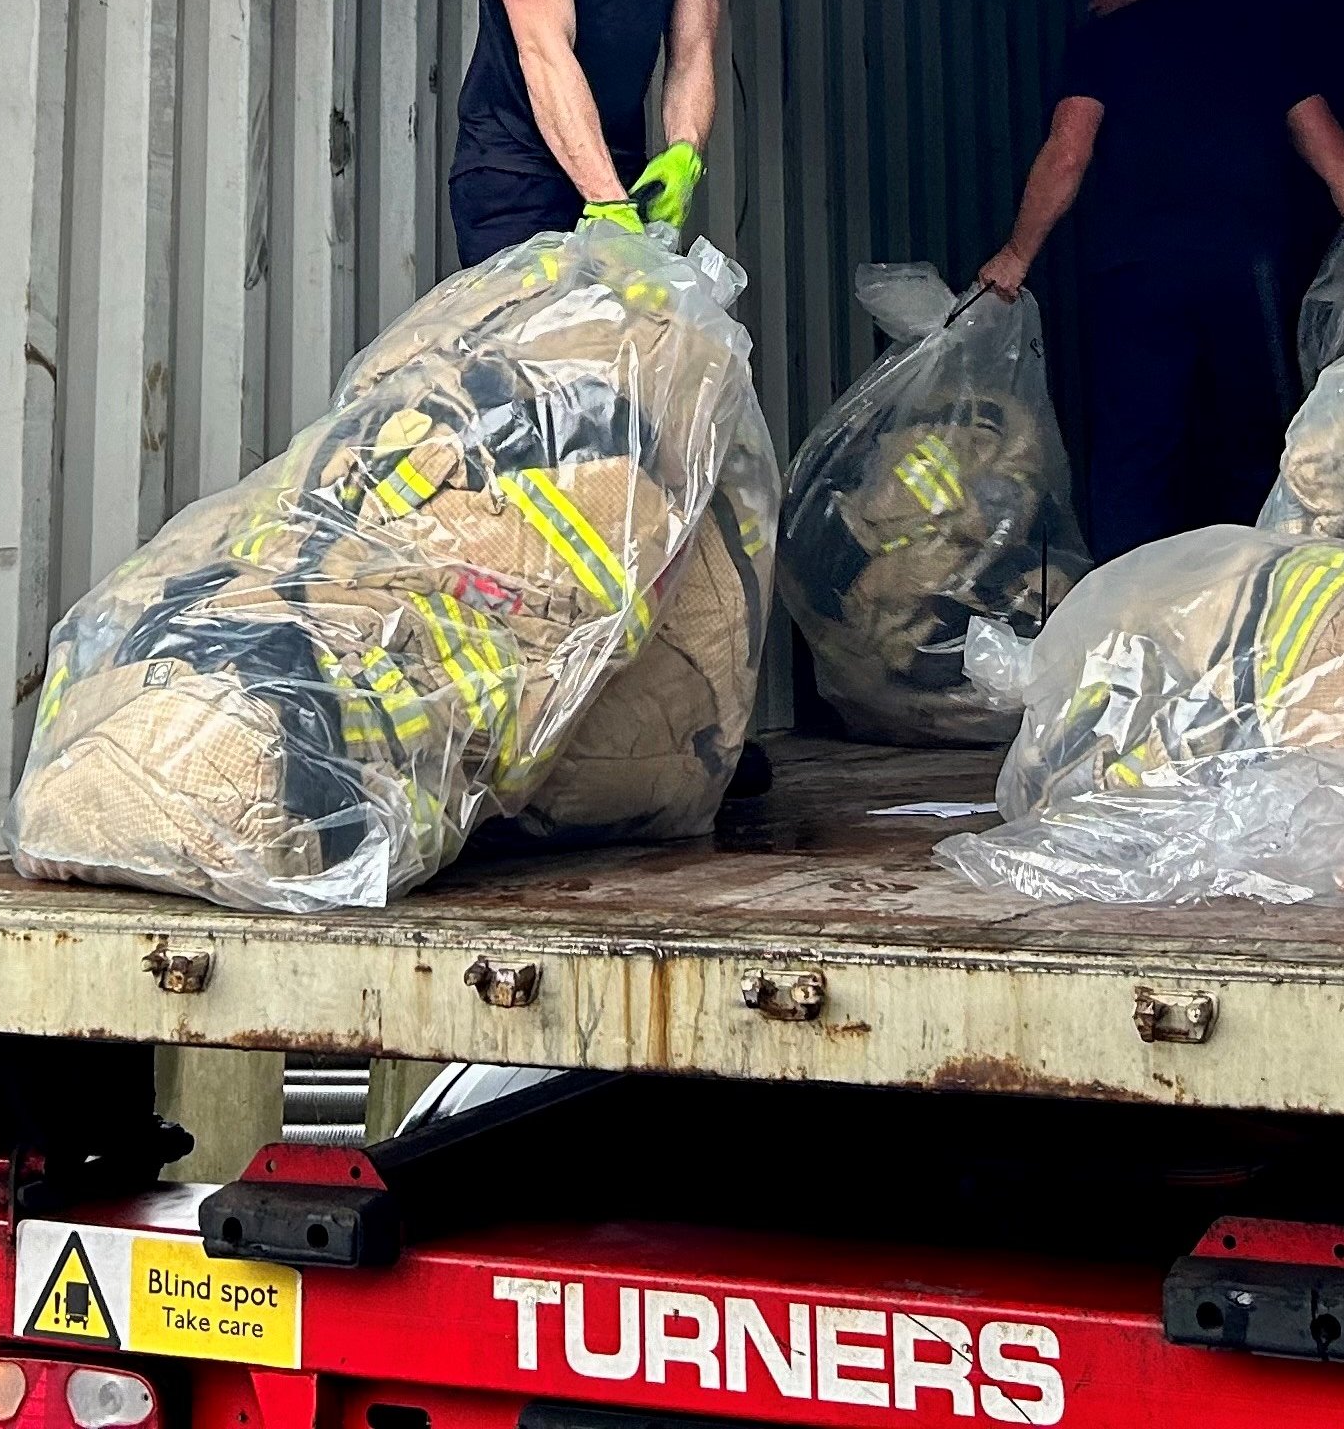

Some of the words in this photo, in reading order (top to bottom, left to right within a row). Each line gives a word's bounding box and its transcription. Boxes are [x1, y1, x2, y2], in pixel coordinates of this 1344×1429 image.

[149, 1268, 211, 1300] Blind
[221, 1283, 279, 1311] spot
[162, 1305, 211, 1332] Take
[218, 1319, 264, 1338] care
[493, 1275, 1065, 1426] TURNERS
